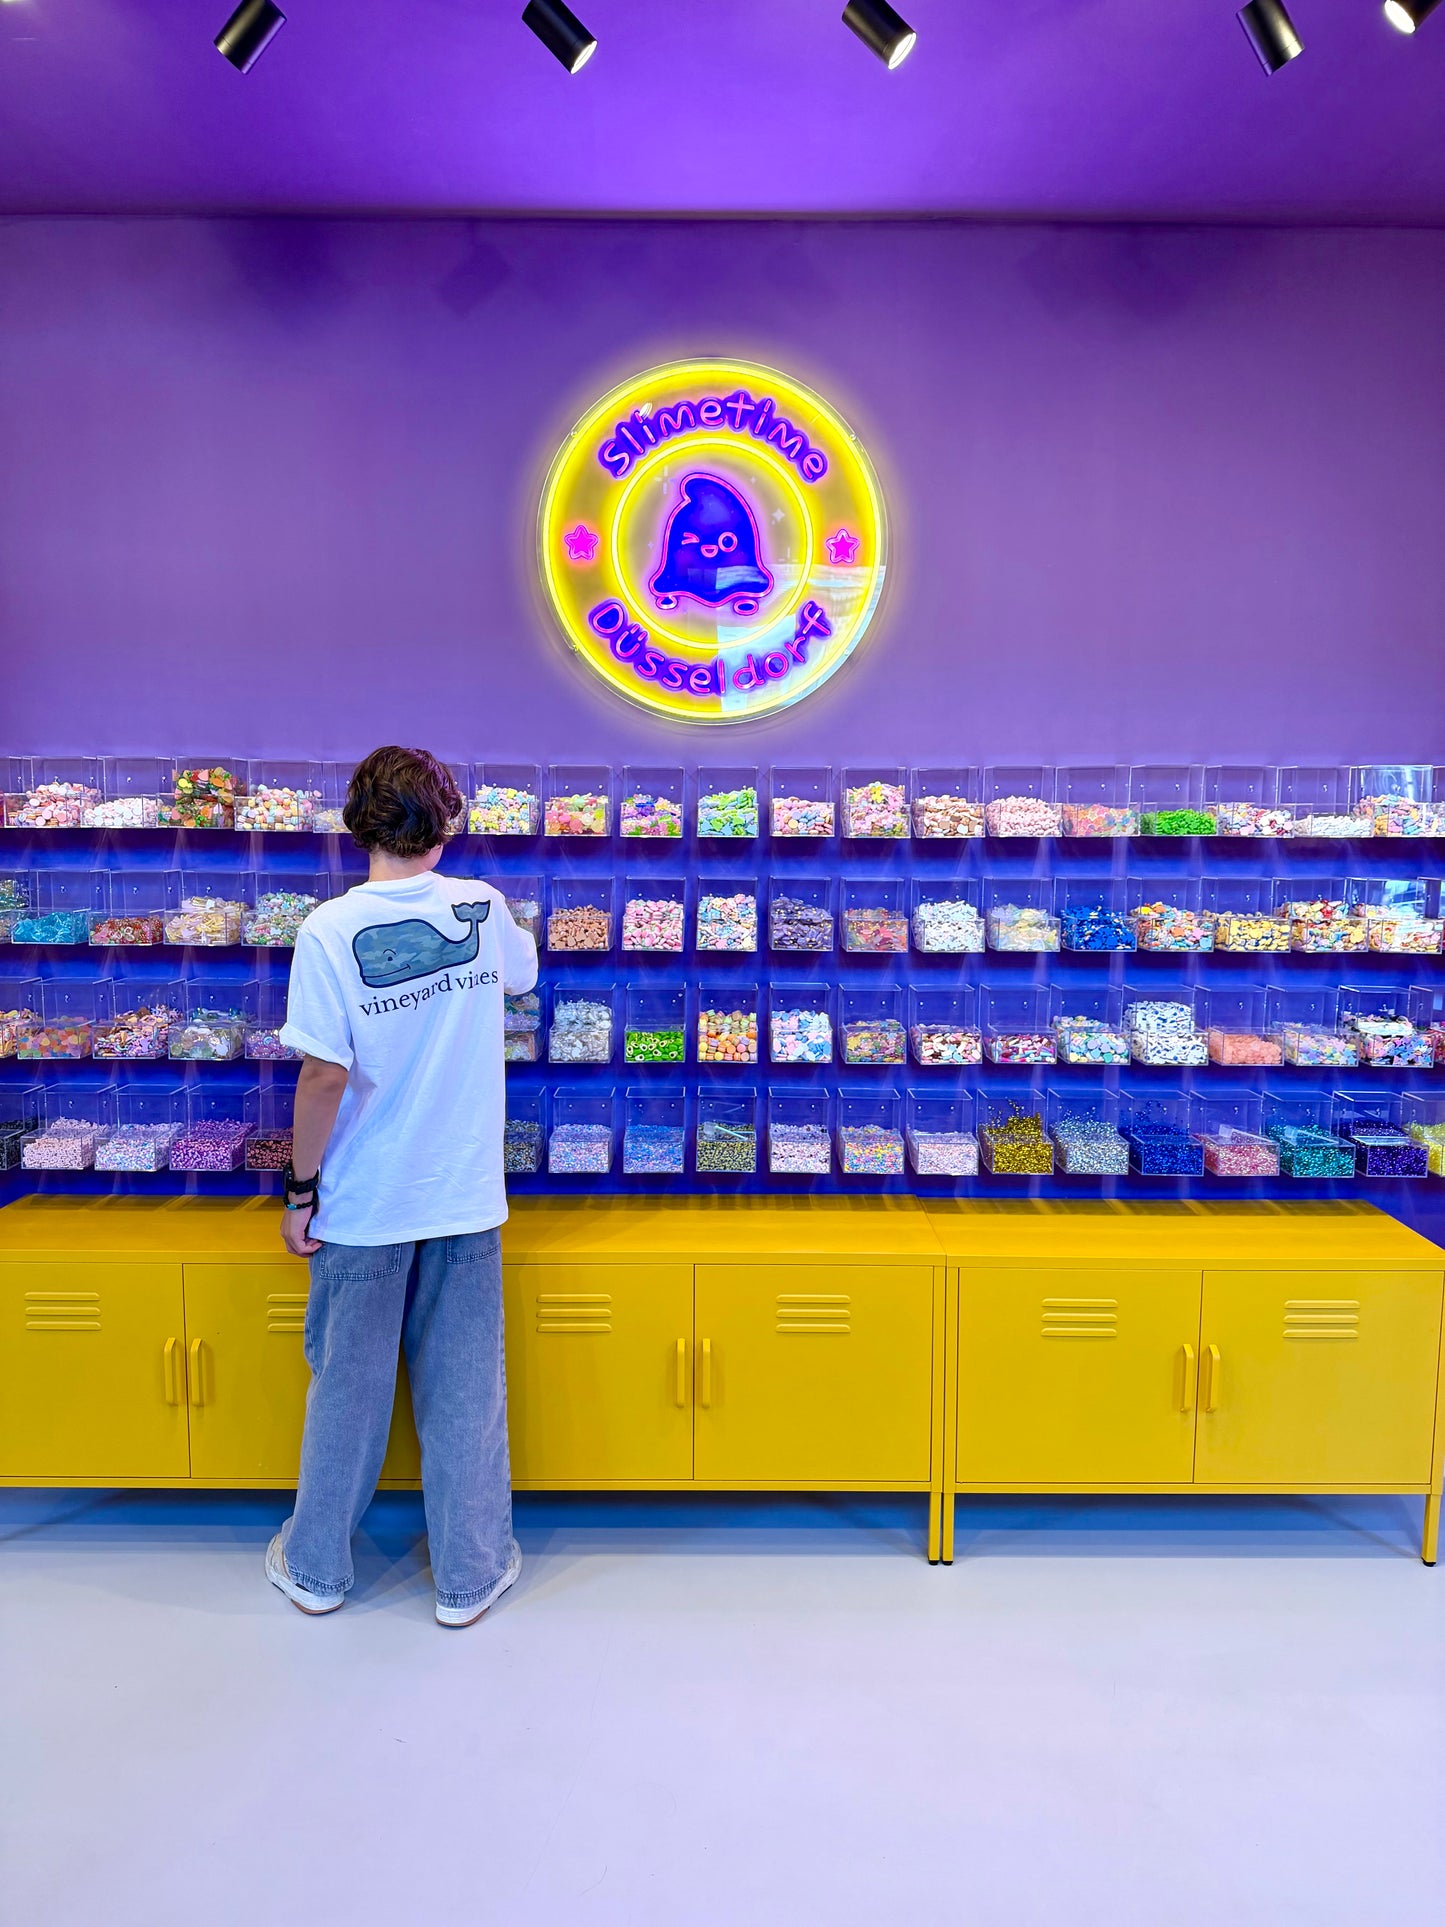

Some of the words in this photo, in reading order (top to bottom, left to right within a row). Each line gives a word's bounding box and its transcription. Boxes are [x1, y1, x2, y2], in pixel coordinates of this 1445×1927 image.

[600, 391, 826, 480] Slimetime
[591, 602, 832, 694] Düsseldorf
[359, 973, 452, 1016] vineyard
